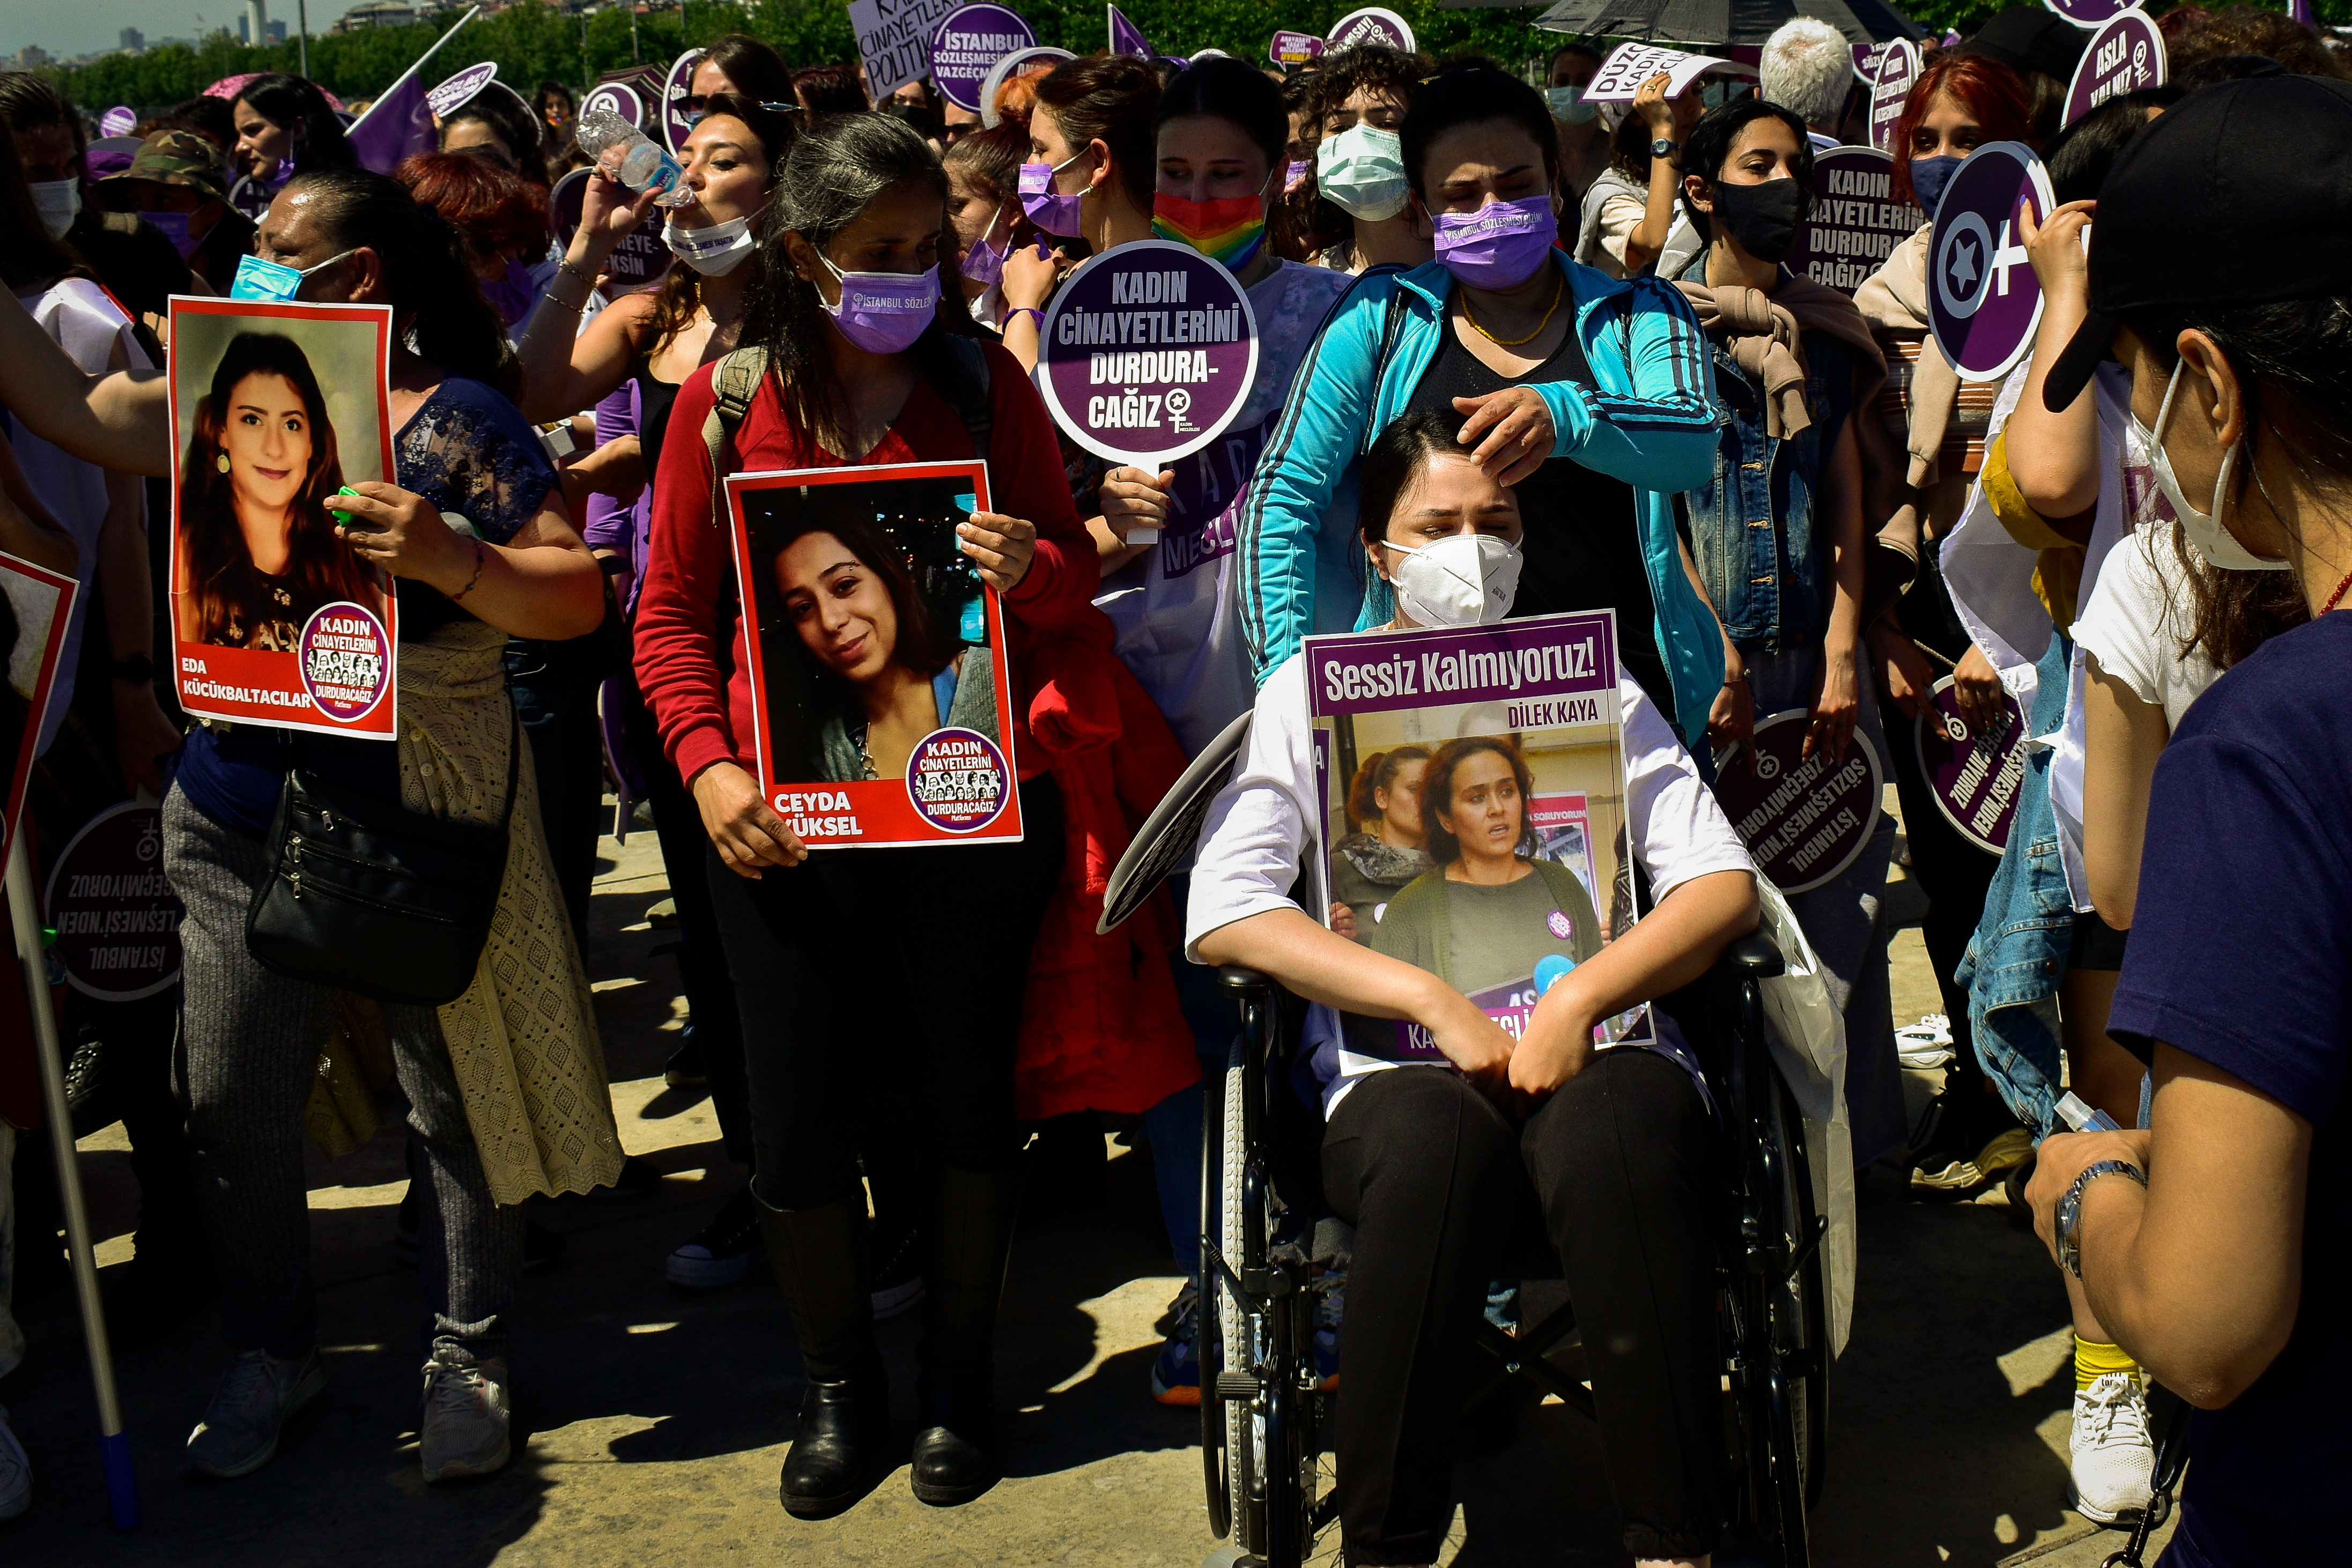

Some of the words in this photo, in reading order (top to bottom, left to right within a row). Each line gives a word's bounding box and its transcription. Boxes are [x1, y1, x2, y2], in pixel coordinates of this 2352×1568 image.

[945, 29, 1026, 51] İSTANBUL
[934, 51, 1008, 65] SÖZLEŞMESİ'
[2096, 30, 2127, 79] ASLA
[1829, 169, 1890, 198] KADIN
[1112, 270, 1187, 304] KADIN
[1808, 258, 1867, 288] CAĞIZ
[864, 294, 903, 309] İSTANBUL
[1059, 303, 1239, 345] CİNAYETLERİNİ
[1090, 350, 1219, 385] DURDURA-
[1088, 387, 1161, 428] CAĞIZ
[320, 617, 370, 636] KADIN
[312, 631, 376, 653] CİNAYETLERİNİ
[181, 657, 207, 675] EDA
[1325, 652, 1418, 701] Sessiz
[1423, 637, 1596, 693] Kalmıyoruz!
[315, 685, 372, 704] DURDURACAĞIZ
[1508, 700, 1554, 729] DİLEK
[1557, 698, 1599, 723] KAYA
[920, 753, 992, 771] CİNAYETLERİNİ
[927, 741, 982, 757] KADIN
[774, 791, 852, 813] CEYDA
[927, 797, 995, 816] DURDURACAĞIZ
[1787, 807, 1861, 873] İSTANBUL
[57, 903, 180, 938] LEŞMESİ'NDEN
[88, 945, 166, 973] İSTANBUL
